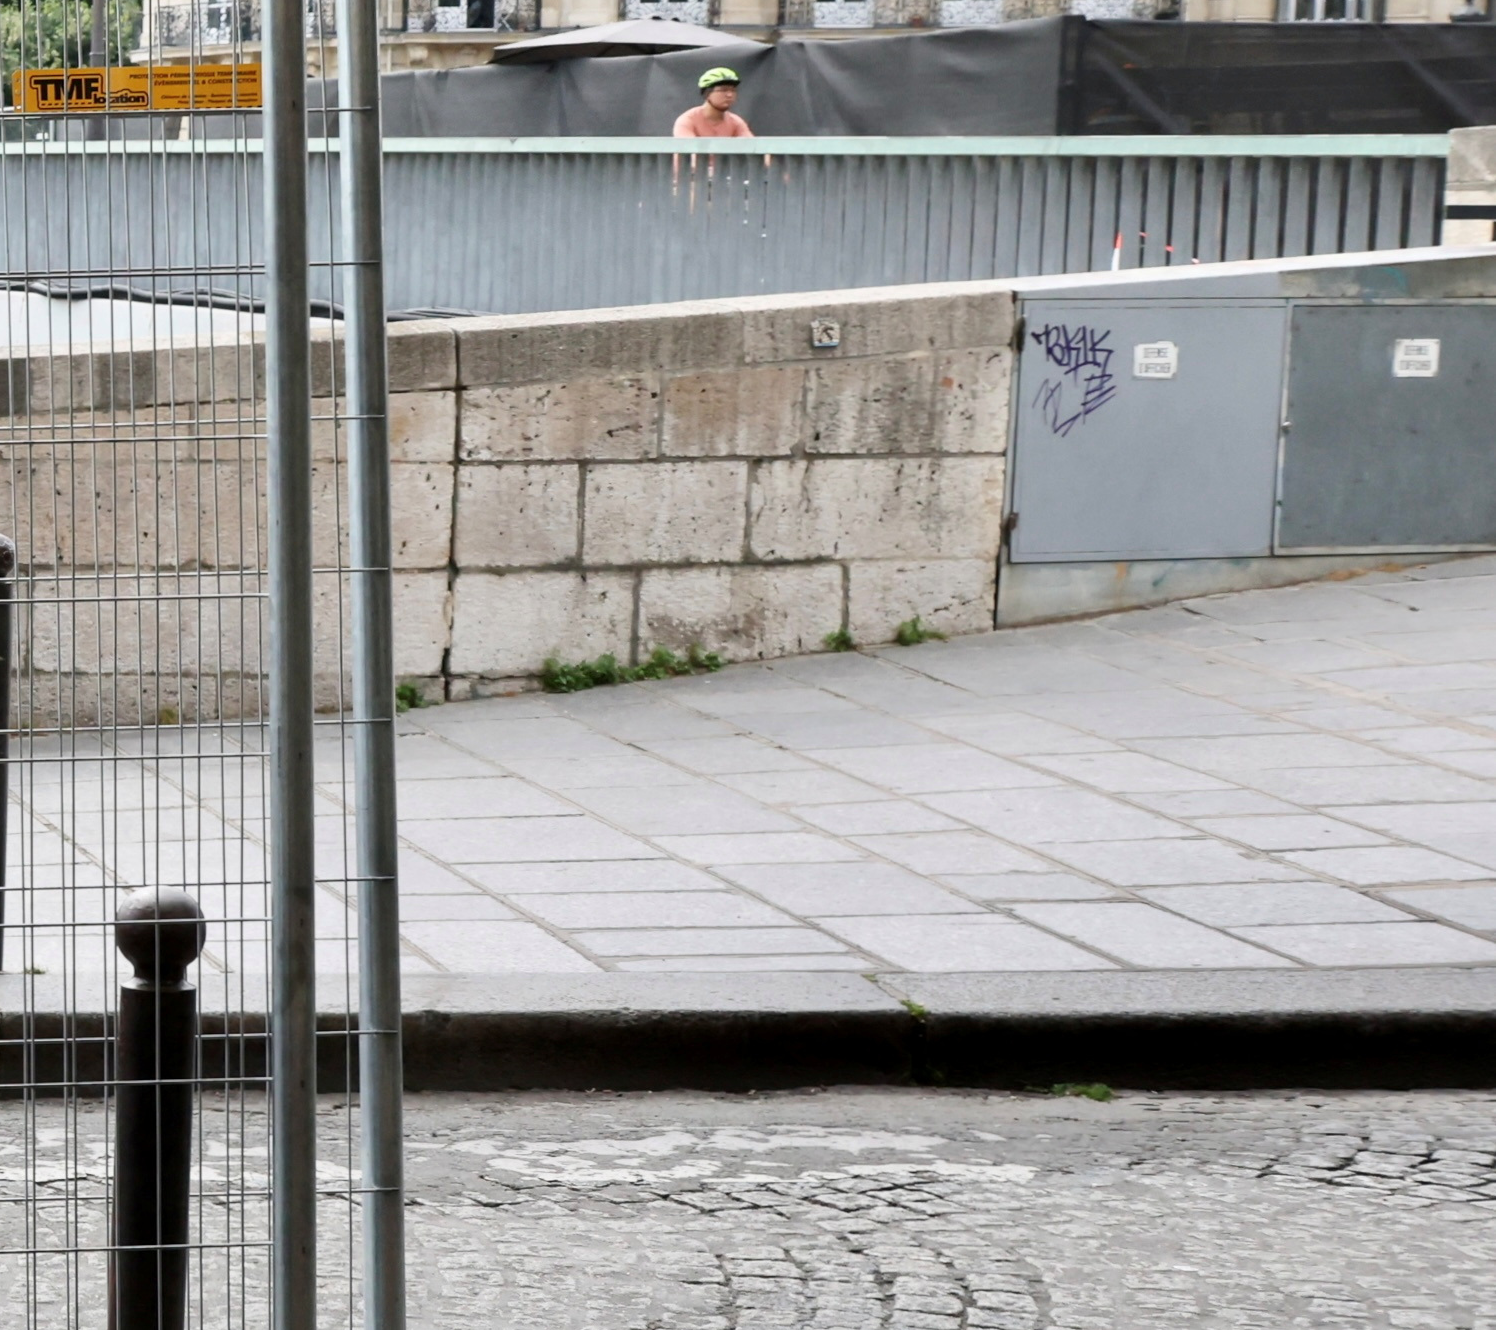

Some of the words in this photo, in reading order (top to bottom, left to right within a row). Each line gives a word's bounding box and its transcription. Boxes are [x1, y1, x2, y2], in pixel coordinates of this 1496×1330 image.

[129, 72, 169, 80] PROTETION
[216, 70, 257, 78] TEMPRAIRE
[207, 77, 258, 85] CONSTRCTION
[33, 77, 100, 101] TMF
